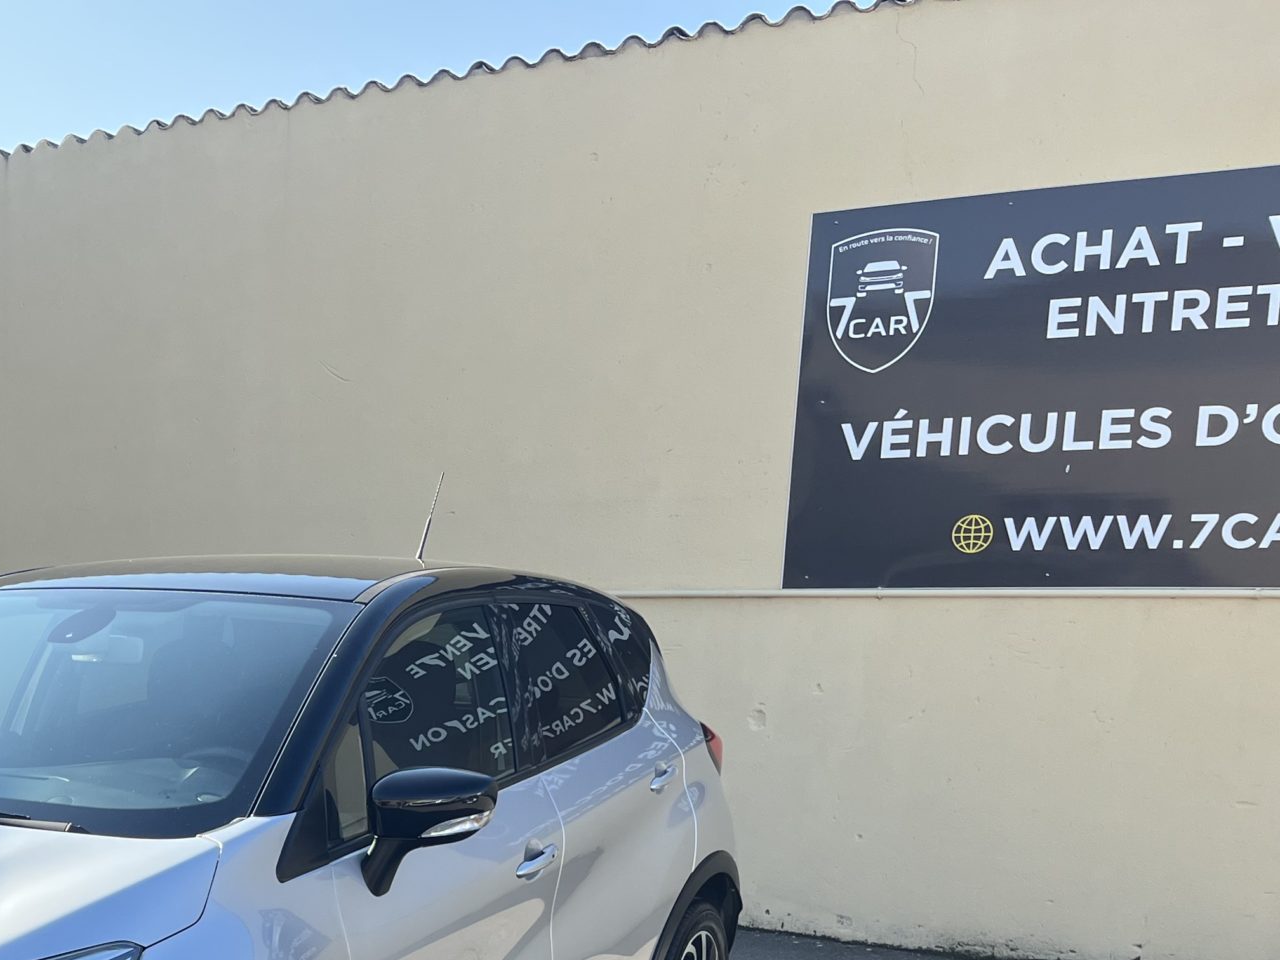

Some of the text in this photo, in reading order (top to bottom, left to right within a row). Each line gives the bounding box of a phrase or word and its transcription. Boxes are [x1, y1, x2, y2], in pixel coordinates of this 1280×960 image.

[838, 245, 849, 253] En
[849, 239, 869, 249] route
[869, 236, 885, 244] vers
[894, 234, 929, 244] confiance
[983, 221, 1203, 279] ACHAT
[1046, 283, 1280, 339] ENTRET
[840, 406, 1173, 461] VÉHICULES
[1003, 512, 1280, 552] WWW.7CA
